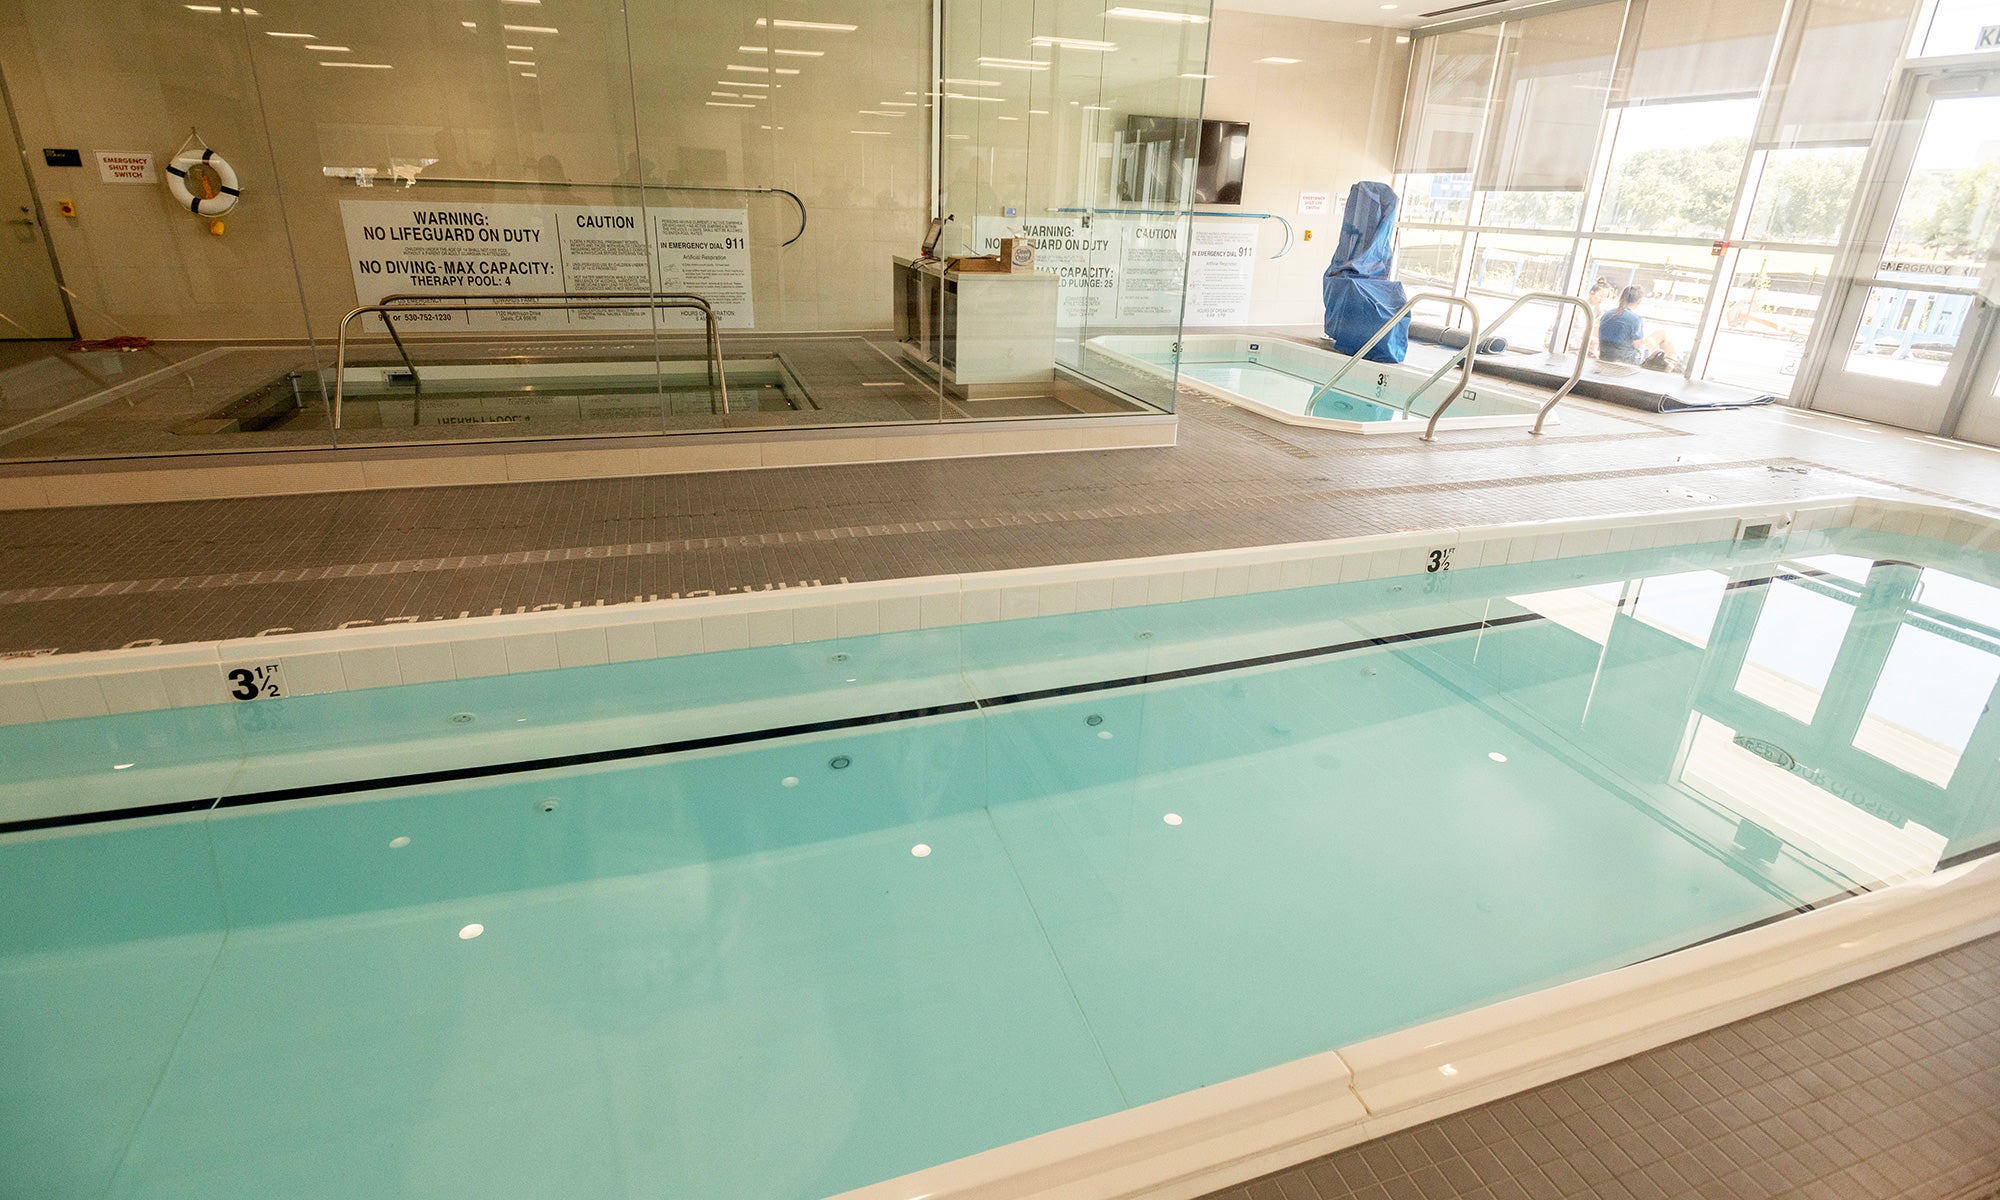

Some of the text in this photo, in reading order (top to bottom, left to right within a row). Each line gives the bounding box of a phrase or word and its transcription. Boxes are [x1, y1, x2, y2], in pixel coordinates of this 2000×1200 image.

[413, 211, 489, 226] WARNING:
[576, 215, 634, 229] CAUTION
[363, 227, 540, 242] NO LIFEGUARD ON DUTY
[1022, 225, 1075, 237] WARNING:
[1136, 228, 1177, 240] CAUTION
[725, 238, 744, 249] 911
[985, 238, 1000, 249] NO
[1065, 239, 1080, 250] ON
[1082, 240, 1109, 251] DUTY
[1238, 246, 1252, 257] 911
[359, 260, 382, 274] NO
[480, 261, 554, 275] CAPACITY:
[1061, 267, 1114, 278] CAPACITY:
[1880, 262, 1981, 277] EMERGENCY XIT
[410, 276, 511, 286] THERAPY POOL: 4
[1069, 279, 1103, 288] PLUNGE:
[1104, 280, 1113, 288] 25
[266, 665, 278, 673] FT
